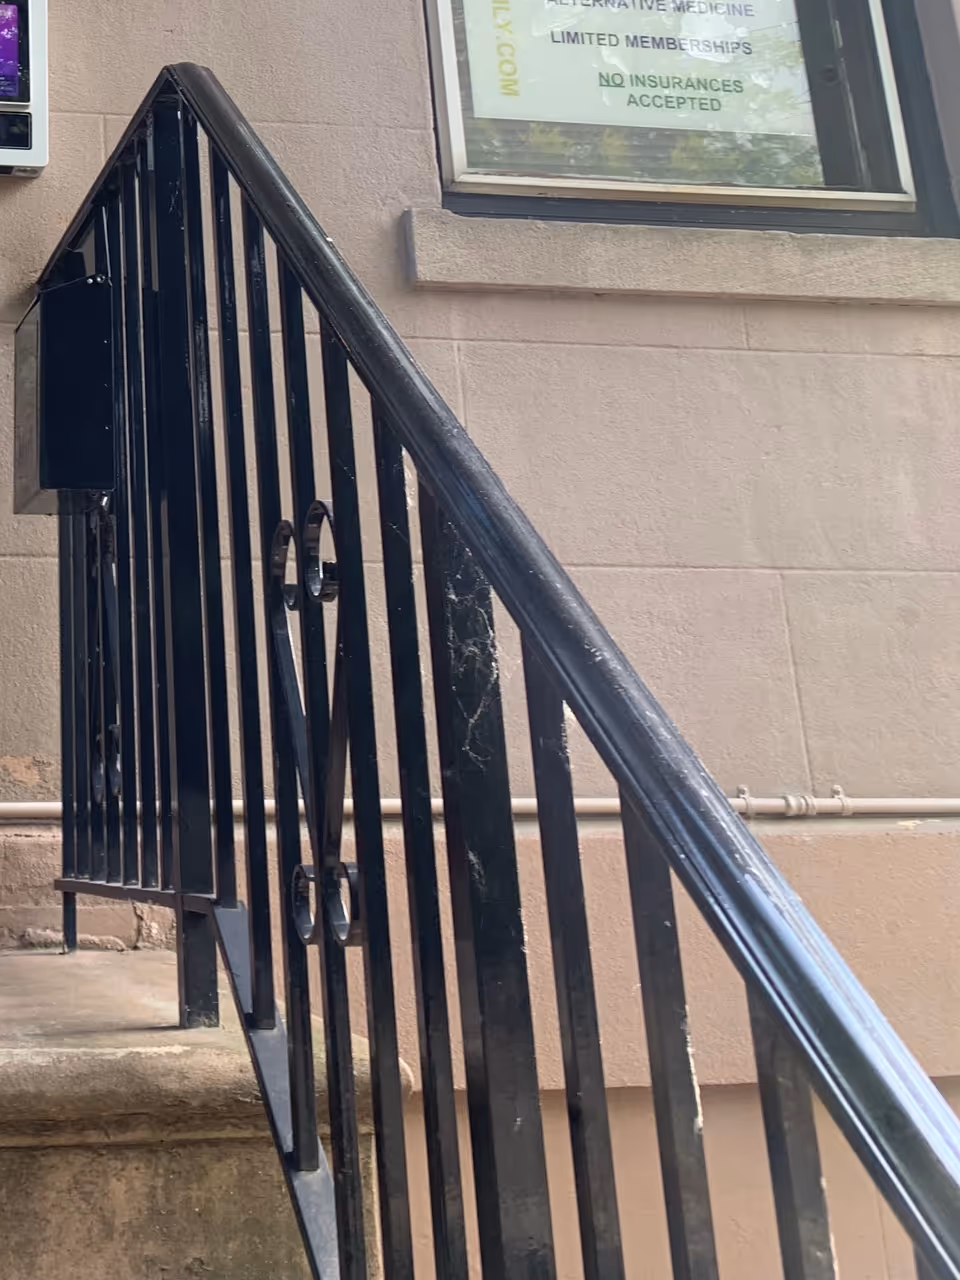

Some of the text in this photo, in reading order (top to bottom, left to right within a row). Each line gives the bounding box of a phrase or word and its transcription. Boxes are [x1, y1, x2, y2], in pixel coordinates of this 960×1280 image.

[671, 0, 755, 17] MEDICINE
[551, 30, 753, 55] LIMITED MEMBERSHIPS
[598, 72, 744, 93] NO INSURANCES
[627, 94, 722, 112] ACCEPTED
